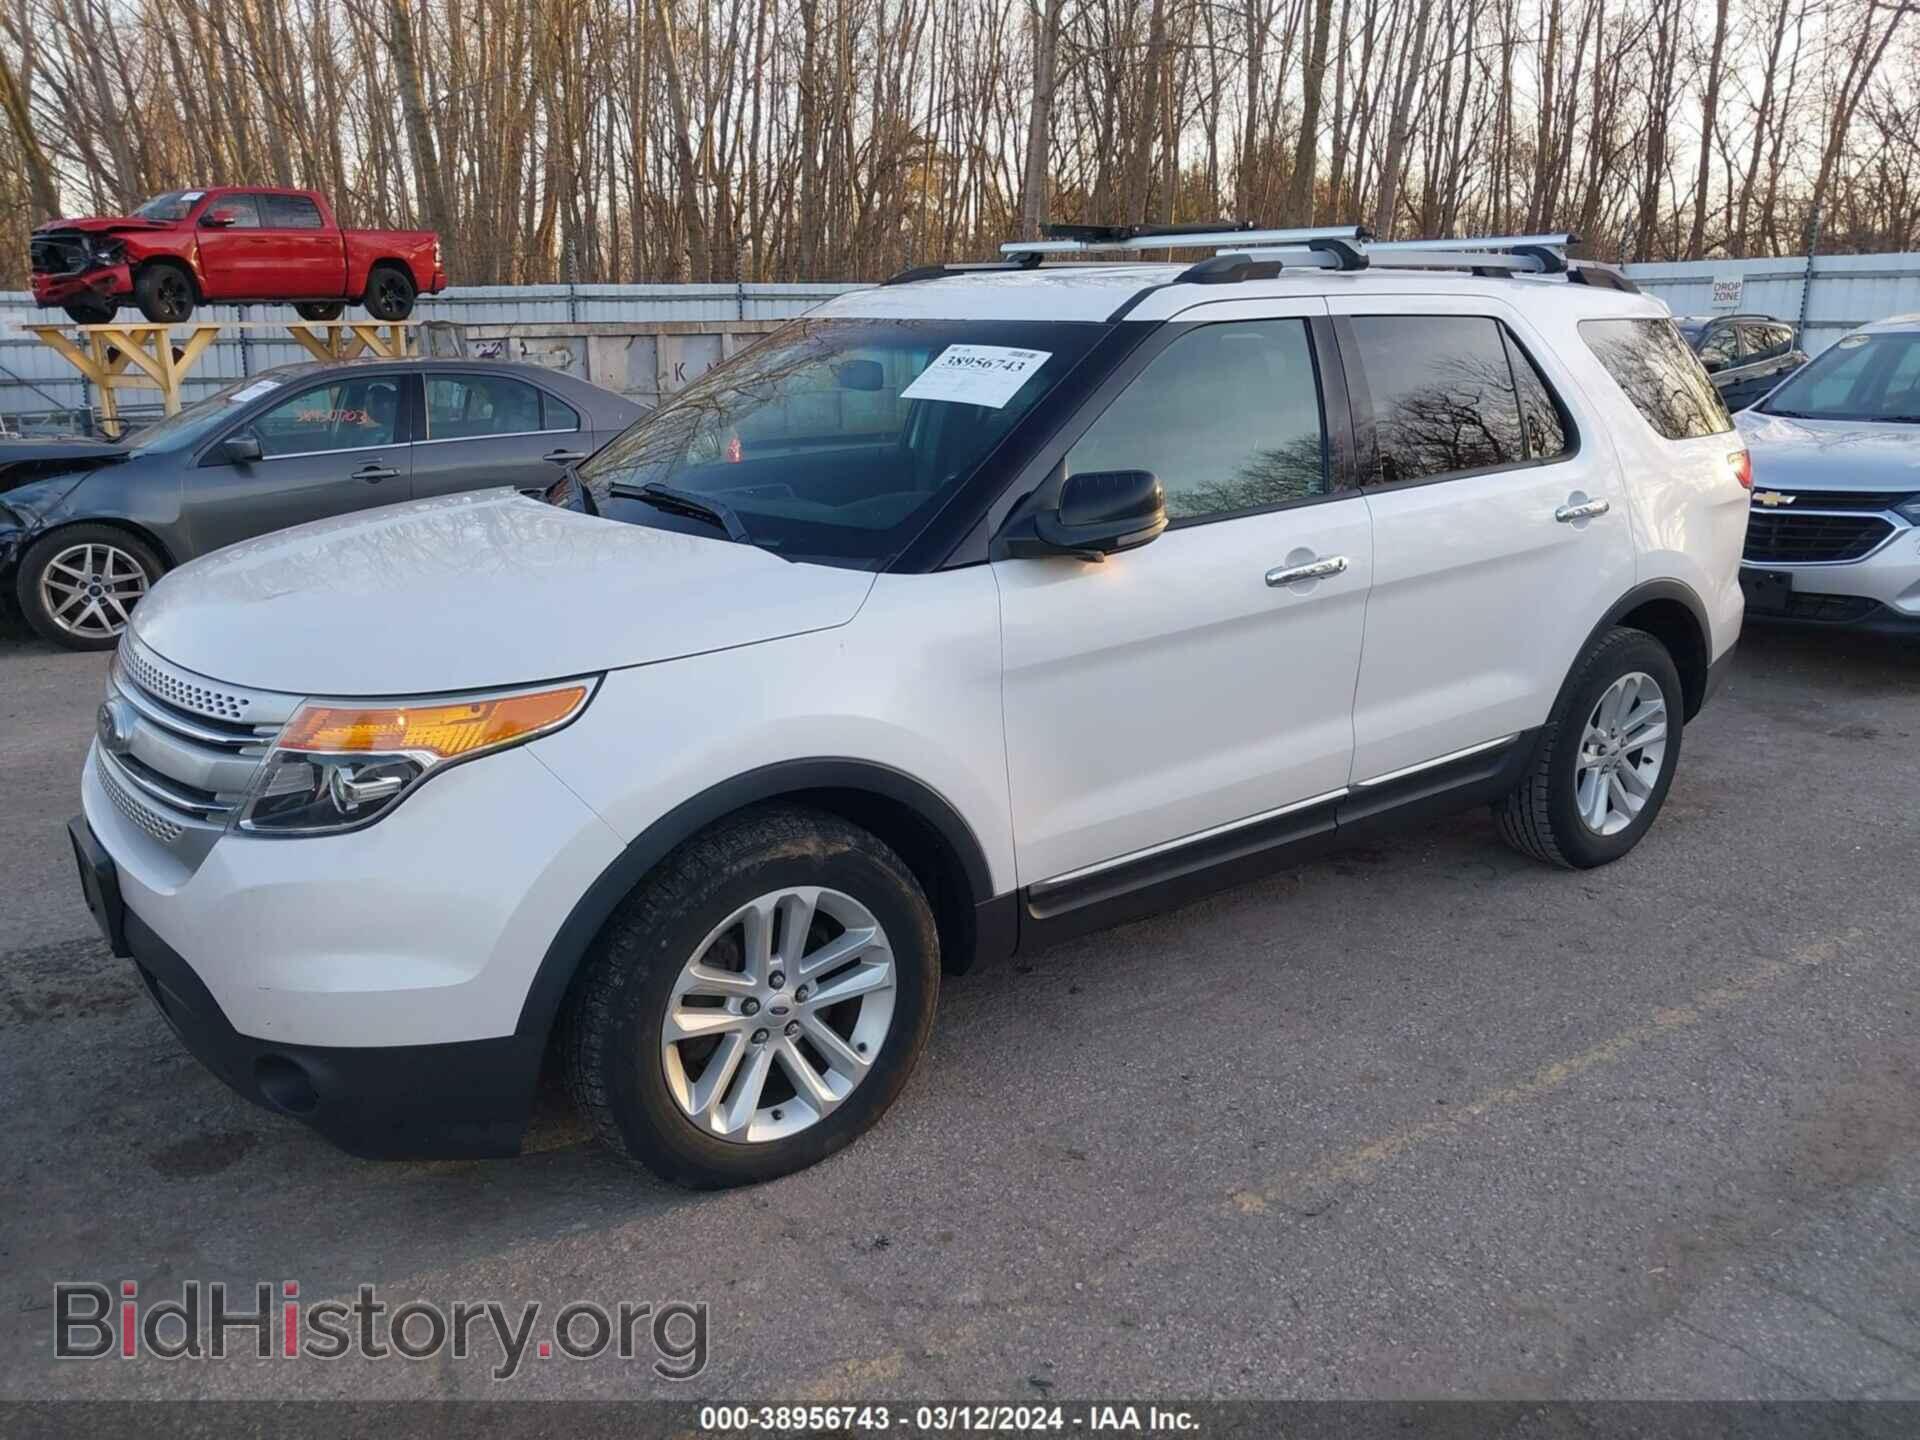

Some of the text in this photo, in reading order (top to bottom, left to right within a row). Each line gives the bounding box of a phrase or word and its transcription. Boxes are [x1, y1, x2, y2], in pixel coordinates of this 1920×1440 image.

[1713, 281, 1741, 292] DROP
[1713, 291, 1740, 301] ZONE
[941, 355, 1026, 372] 38956743
